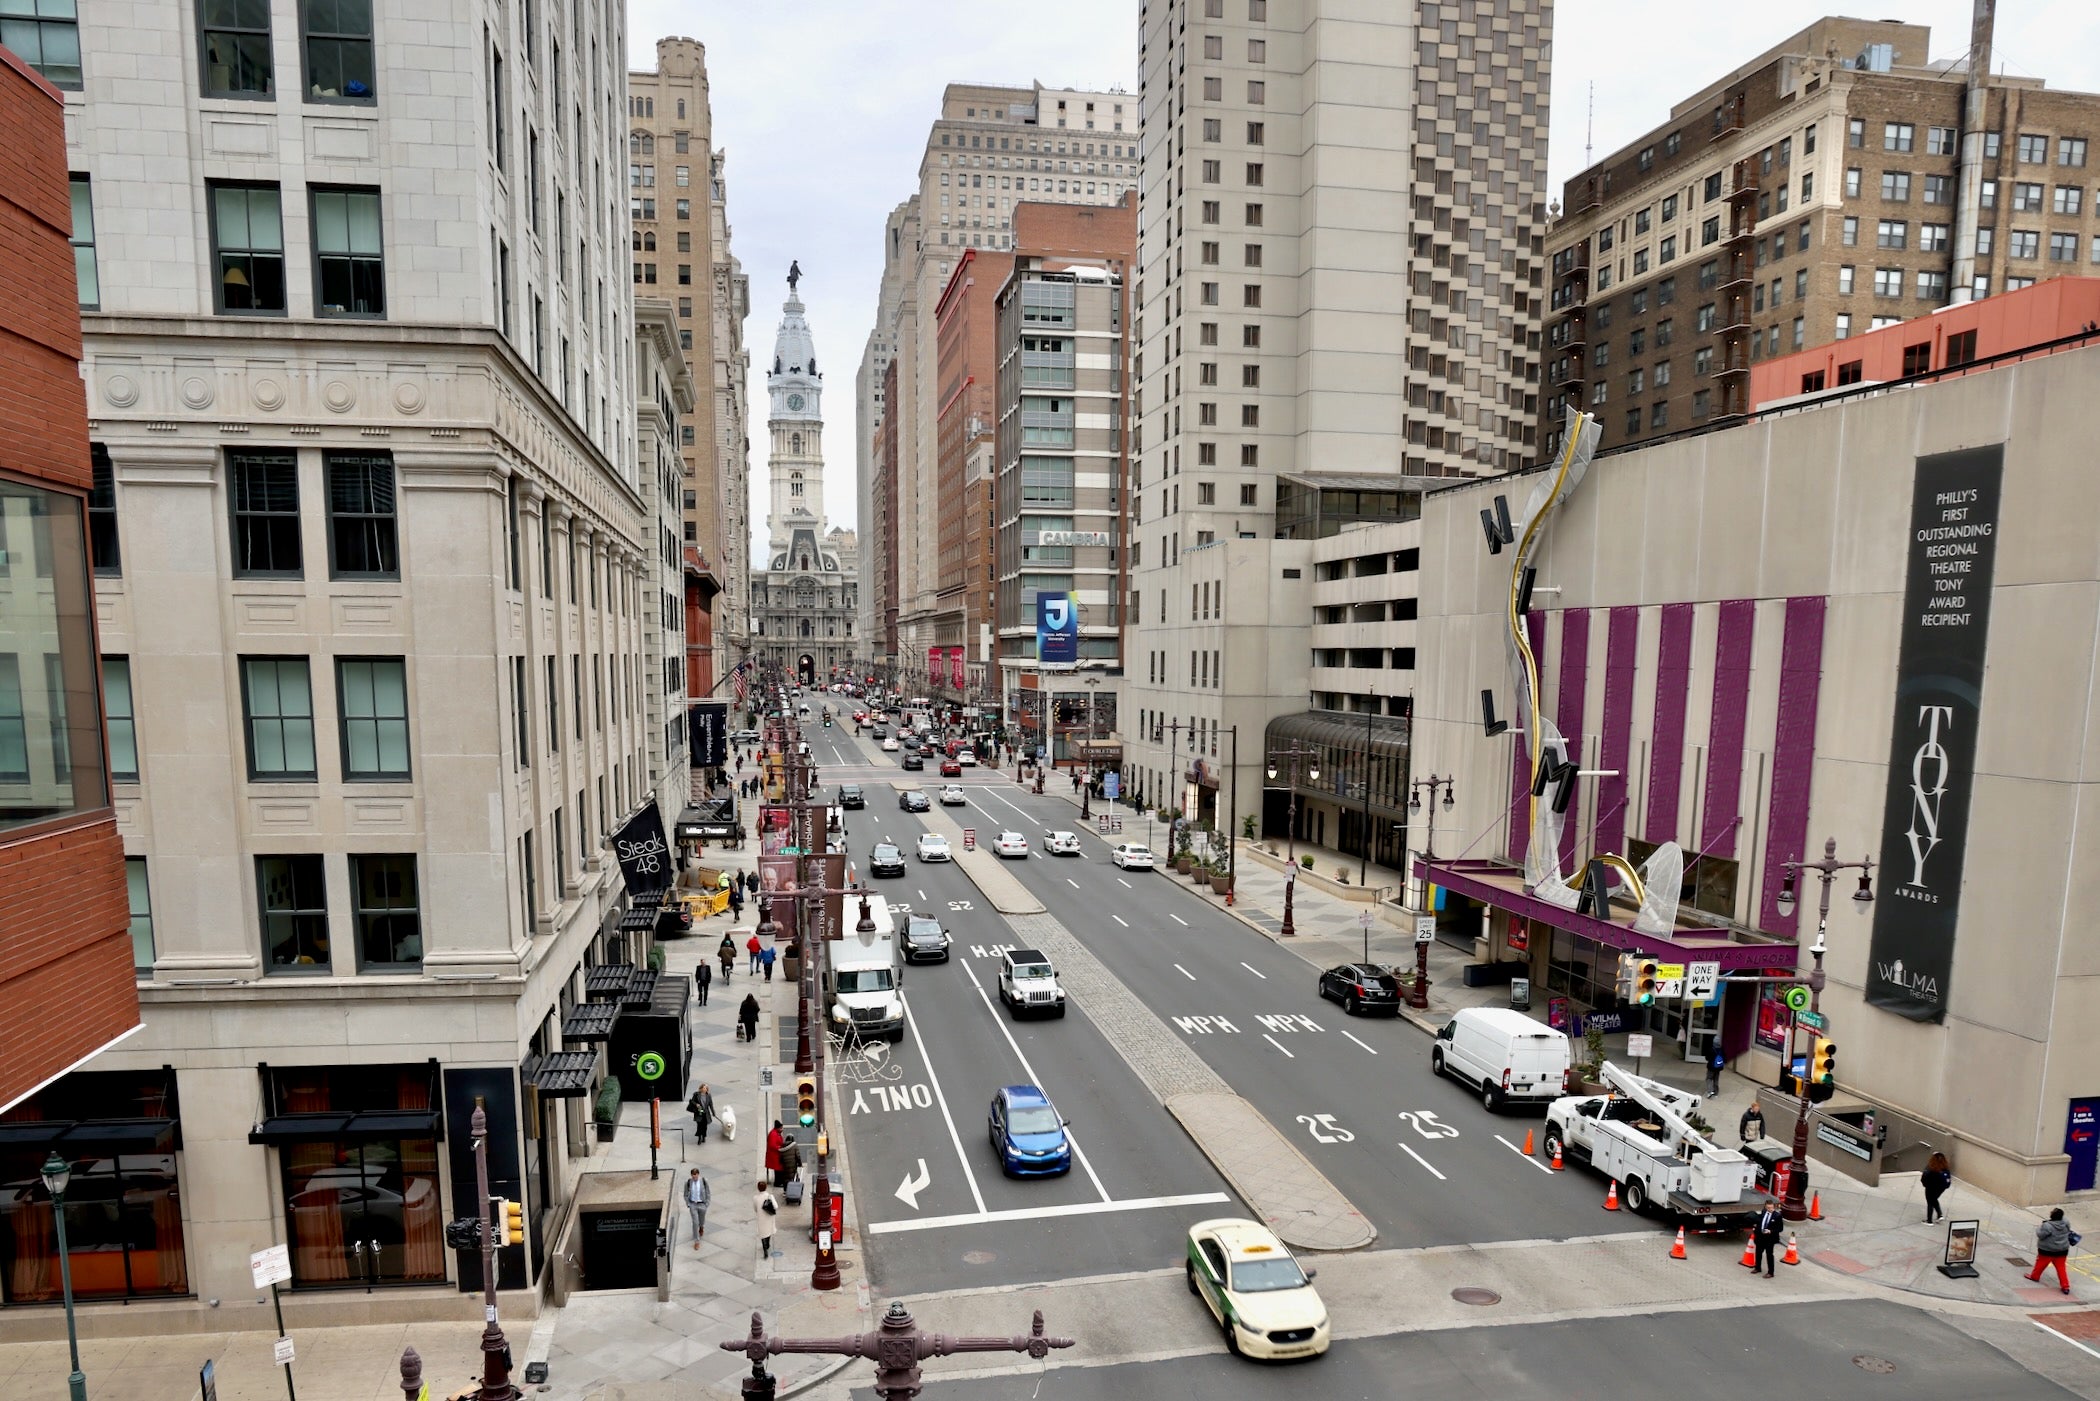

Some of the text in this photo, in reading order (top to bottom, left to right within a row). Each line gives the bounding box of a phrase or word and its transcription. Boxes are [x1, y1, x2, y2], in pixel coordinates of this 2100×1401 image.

[1935, 489, 1978, 505] PHILLY'S
[1941, 508, 1969, 522] FIRST
[1917, 523, 1992, 542] OUTSTANDING
[1926, 543, 1979, 558] REGIONAL
[1930, 560, 1972, 575] THEATRE
[1934, 579, 1963, 592] TONY
[1928, 596, 1966, 609] AWARD
[1921, 613, 1971, 627] RECIPIENT
[1904, 705, 1953, 889] TONY
[618, 831, 665, 858] Steak
[636, 855, 660, 874] 48
[1894, 888, 1939, 904] AWARDS
[948, 901, 973, 911] 25
[827, 917, 835, 936] Philly
[1419, 929, 1432, 939] 25
[1694, 965, 1713, 975] ONE
[1878, 958, 1938, 995] WILMA
[1692, 976, 1713, 984] WAY
[1909, 988, 1938, 1004] THEATER
[1171, 1015, 1241, 1034] MPH
[1254, 1014, 1326, 1033] MPH
[1591, 1013, 1621, 1023] WILMA
[1591, 1021, 1621, 1030] THEATER
[850, 1083, 933, 1115] ONLY
[1296, 1114, 1355, 1143] 25
[1398, 1110, 1460, 1139] 25
